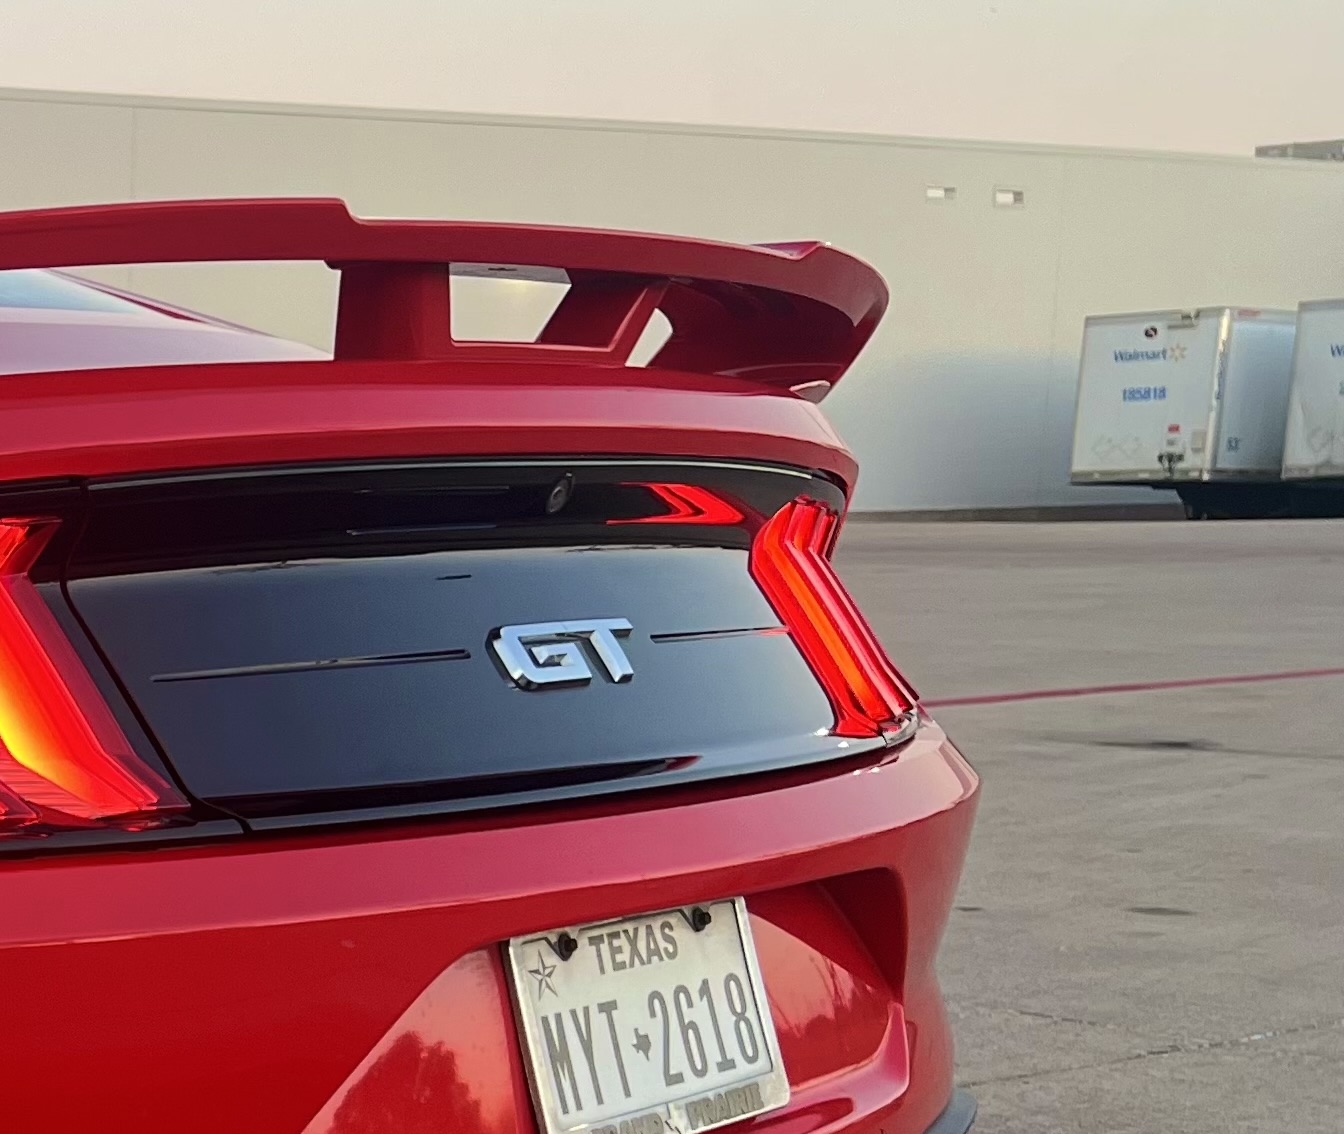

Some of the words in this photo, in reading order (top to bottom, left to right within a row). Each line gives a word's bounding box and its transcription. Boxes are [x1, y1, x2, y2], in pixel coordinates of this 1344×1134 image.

[1114, 347, 1167, 362] Walmart
[485, 617, 635, 692] GT
[588, 920, 679, 975] TEXAS
[541, 1000, 632, 1115] MYT
[647, 972, 760, 1087] 2618
[685, 1081, 764, 1131] PRAIRIE
